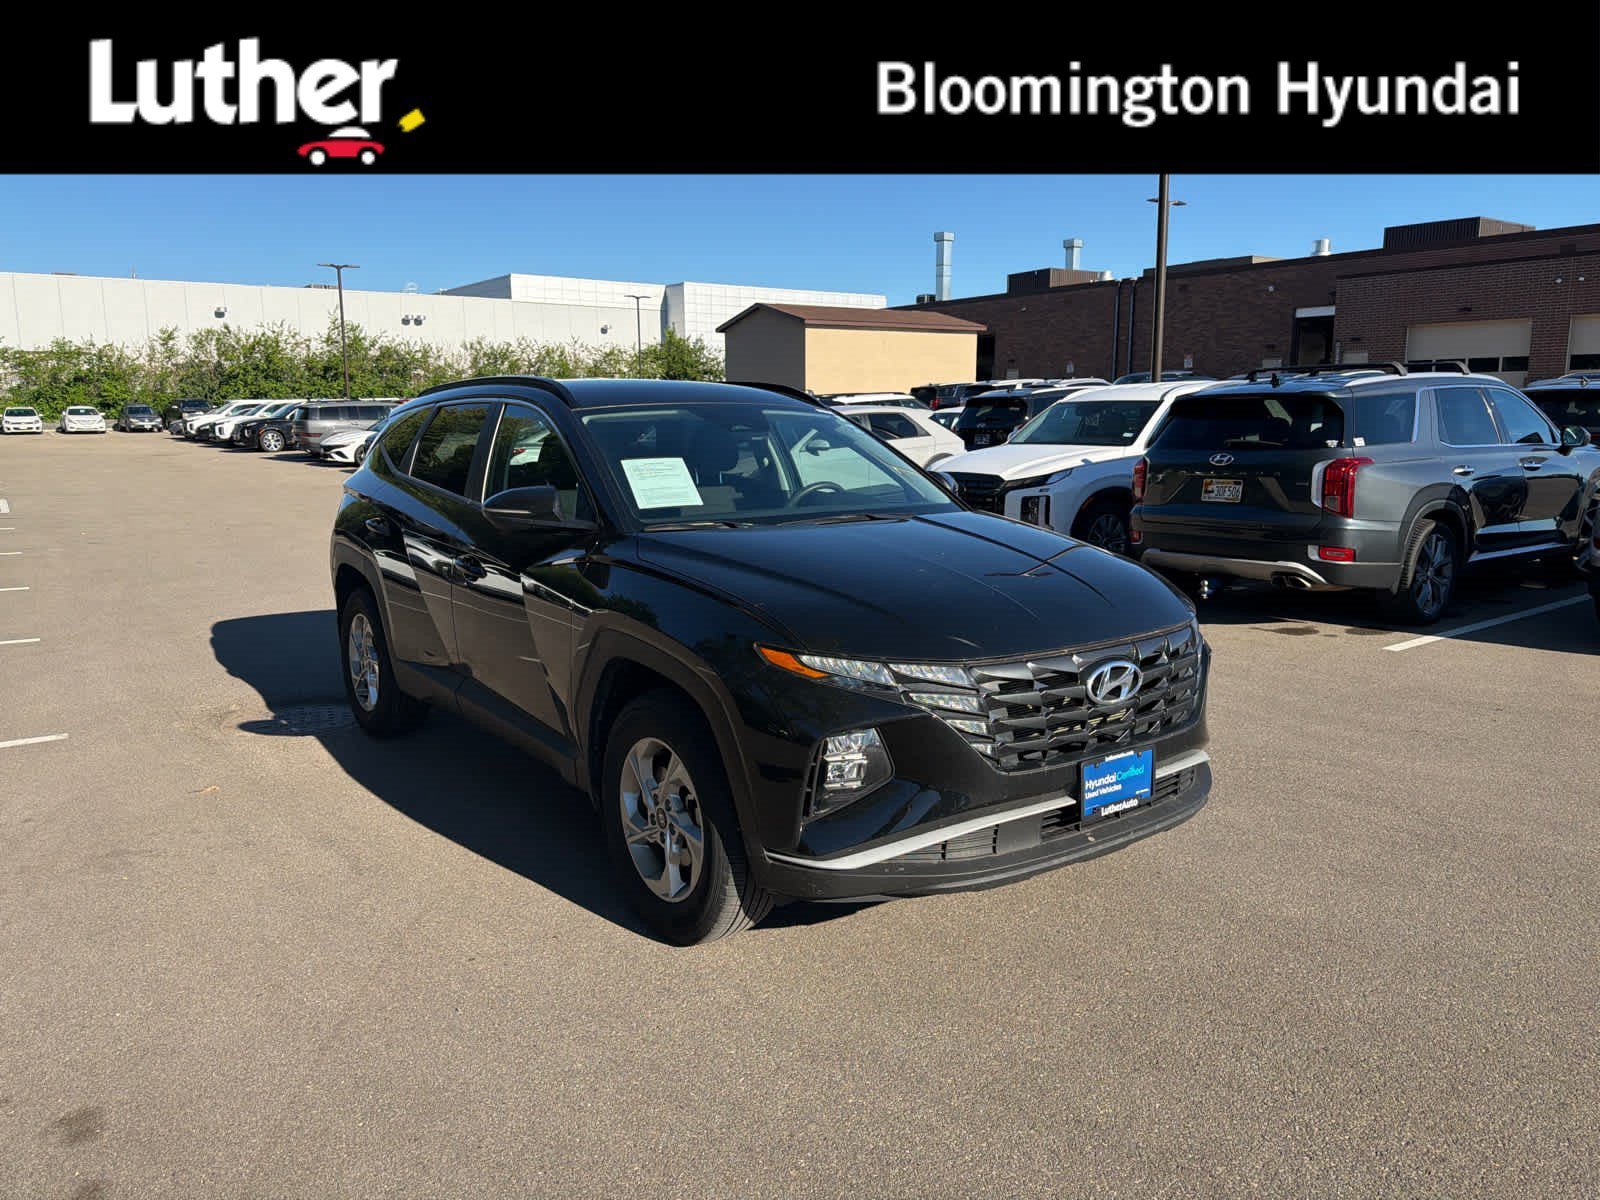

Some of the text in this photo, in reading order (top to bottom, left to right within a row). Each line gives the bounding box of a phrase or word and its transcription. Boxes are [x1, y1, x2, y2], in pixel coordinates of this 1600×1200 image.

[1085, 772, 1117, 790] Hyundai
[1084, 789, 1099, 800] Used
[1099, 784, 1122, 795] Vehicles
[1101, 798, 1138, 816] LutherAuto
